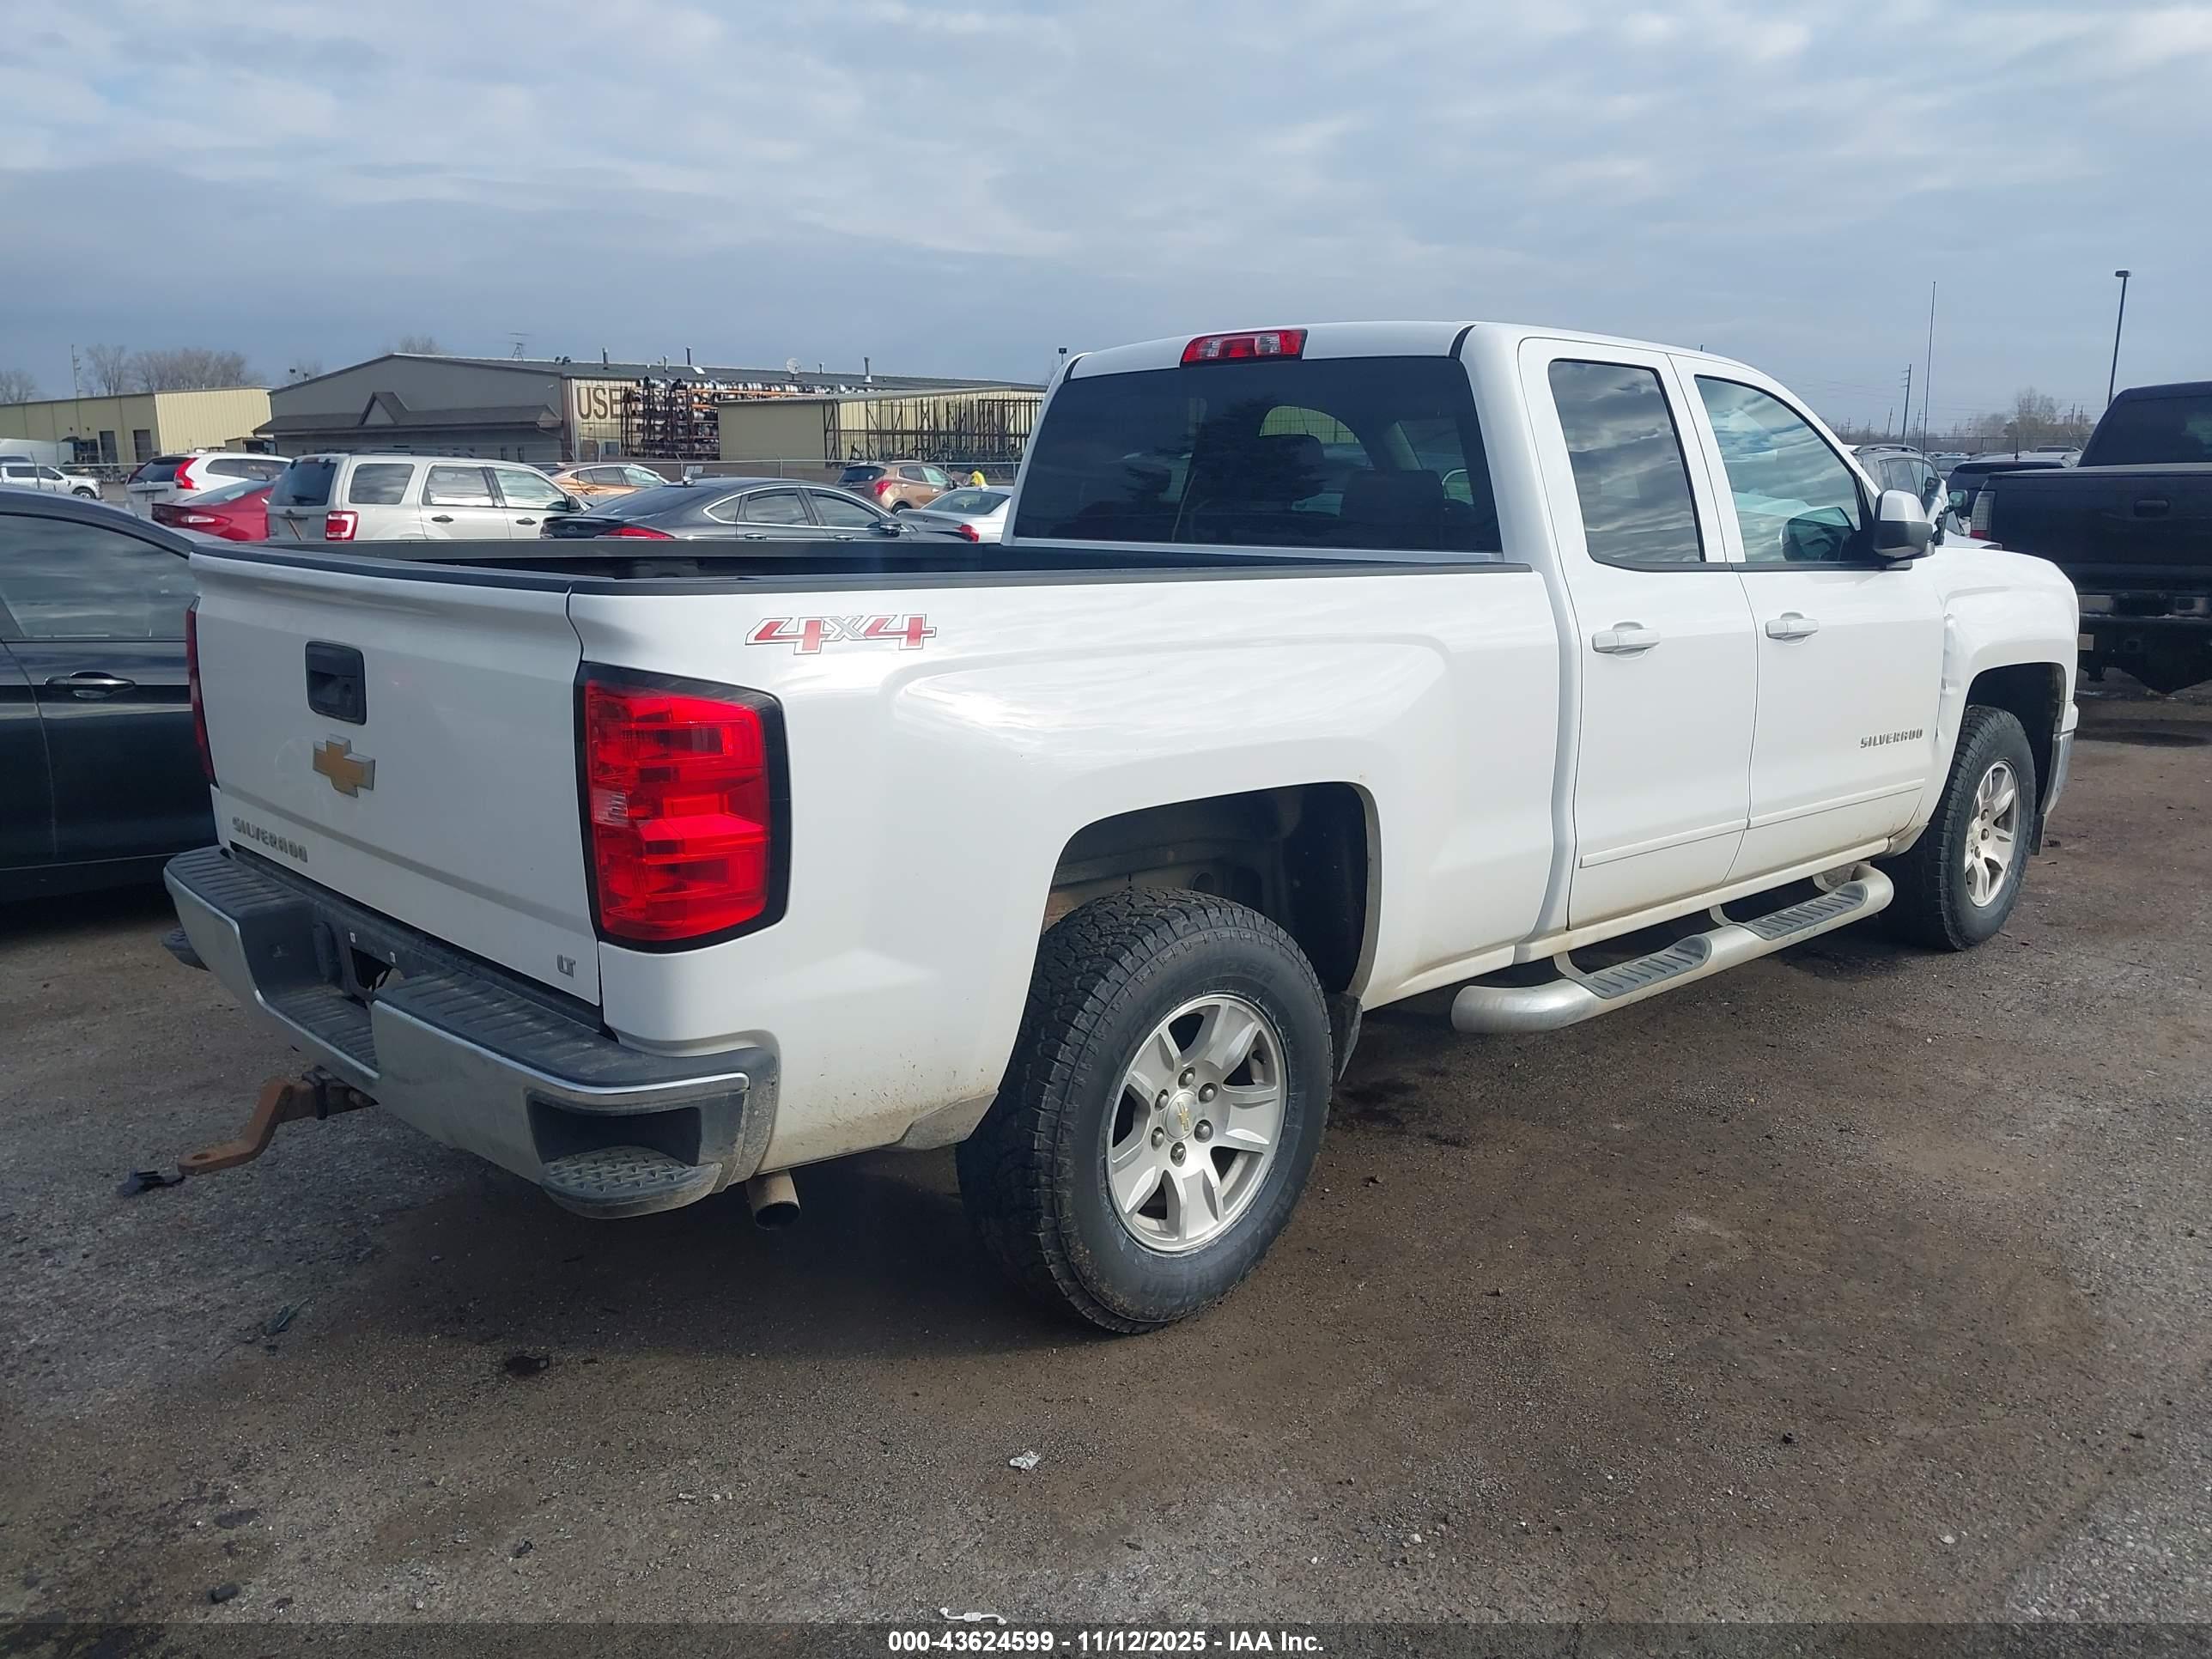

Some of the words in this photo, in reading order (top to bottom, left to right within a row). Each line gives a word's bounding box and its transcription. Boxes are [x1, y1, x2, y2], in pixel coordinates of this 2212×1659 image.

[1860, 727, 1923, 749] SILVERADO
[231, 816, 308, 864] SILVERADO
[556, 953, 576, 979] LT
